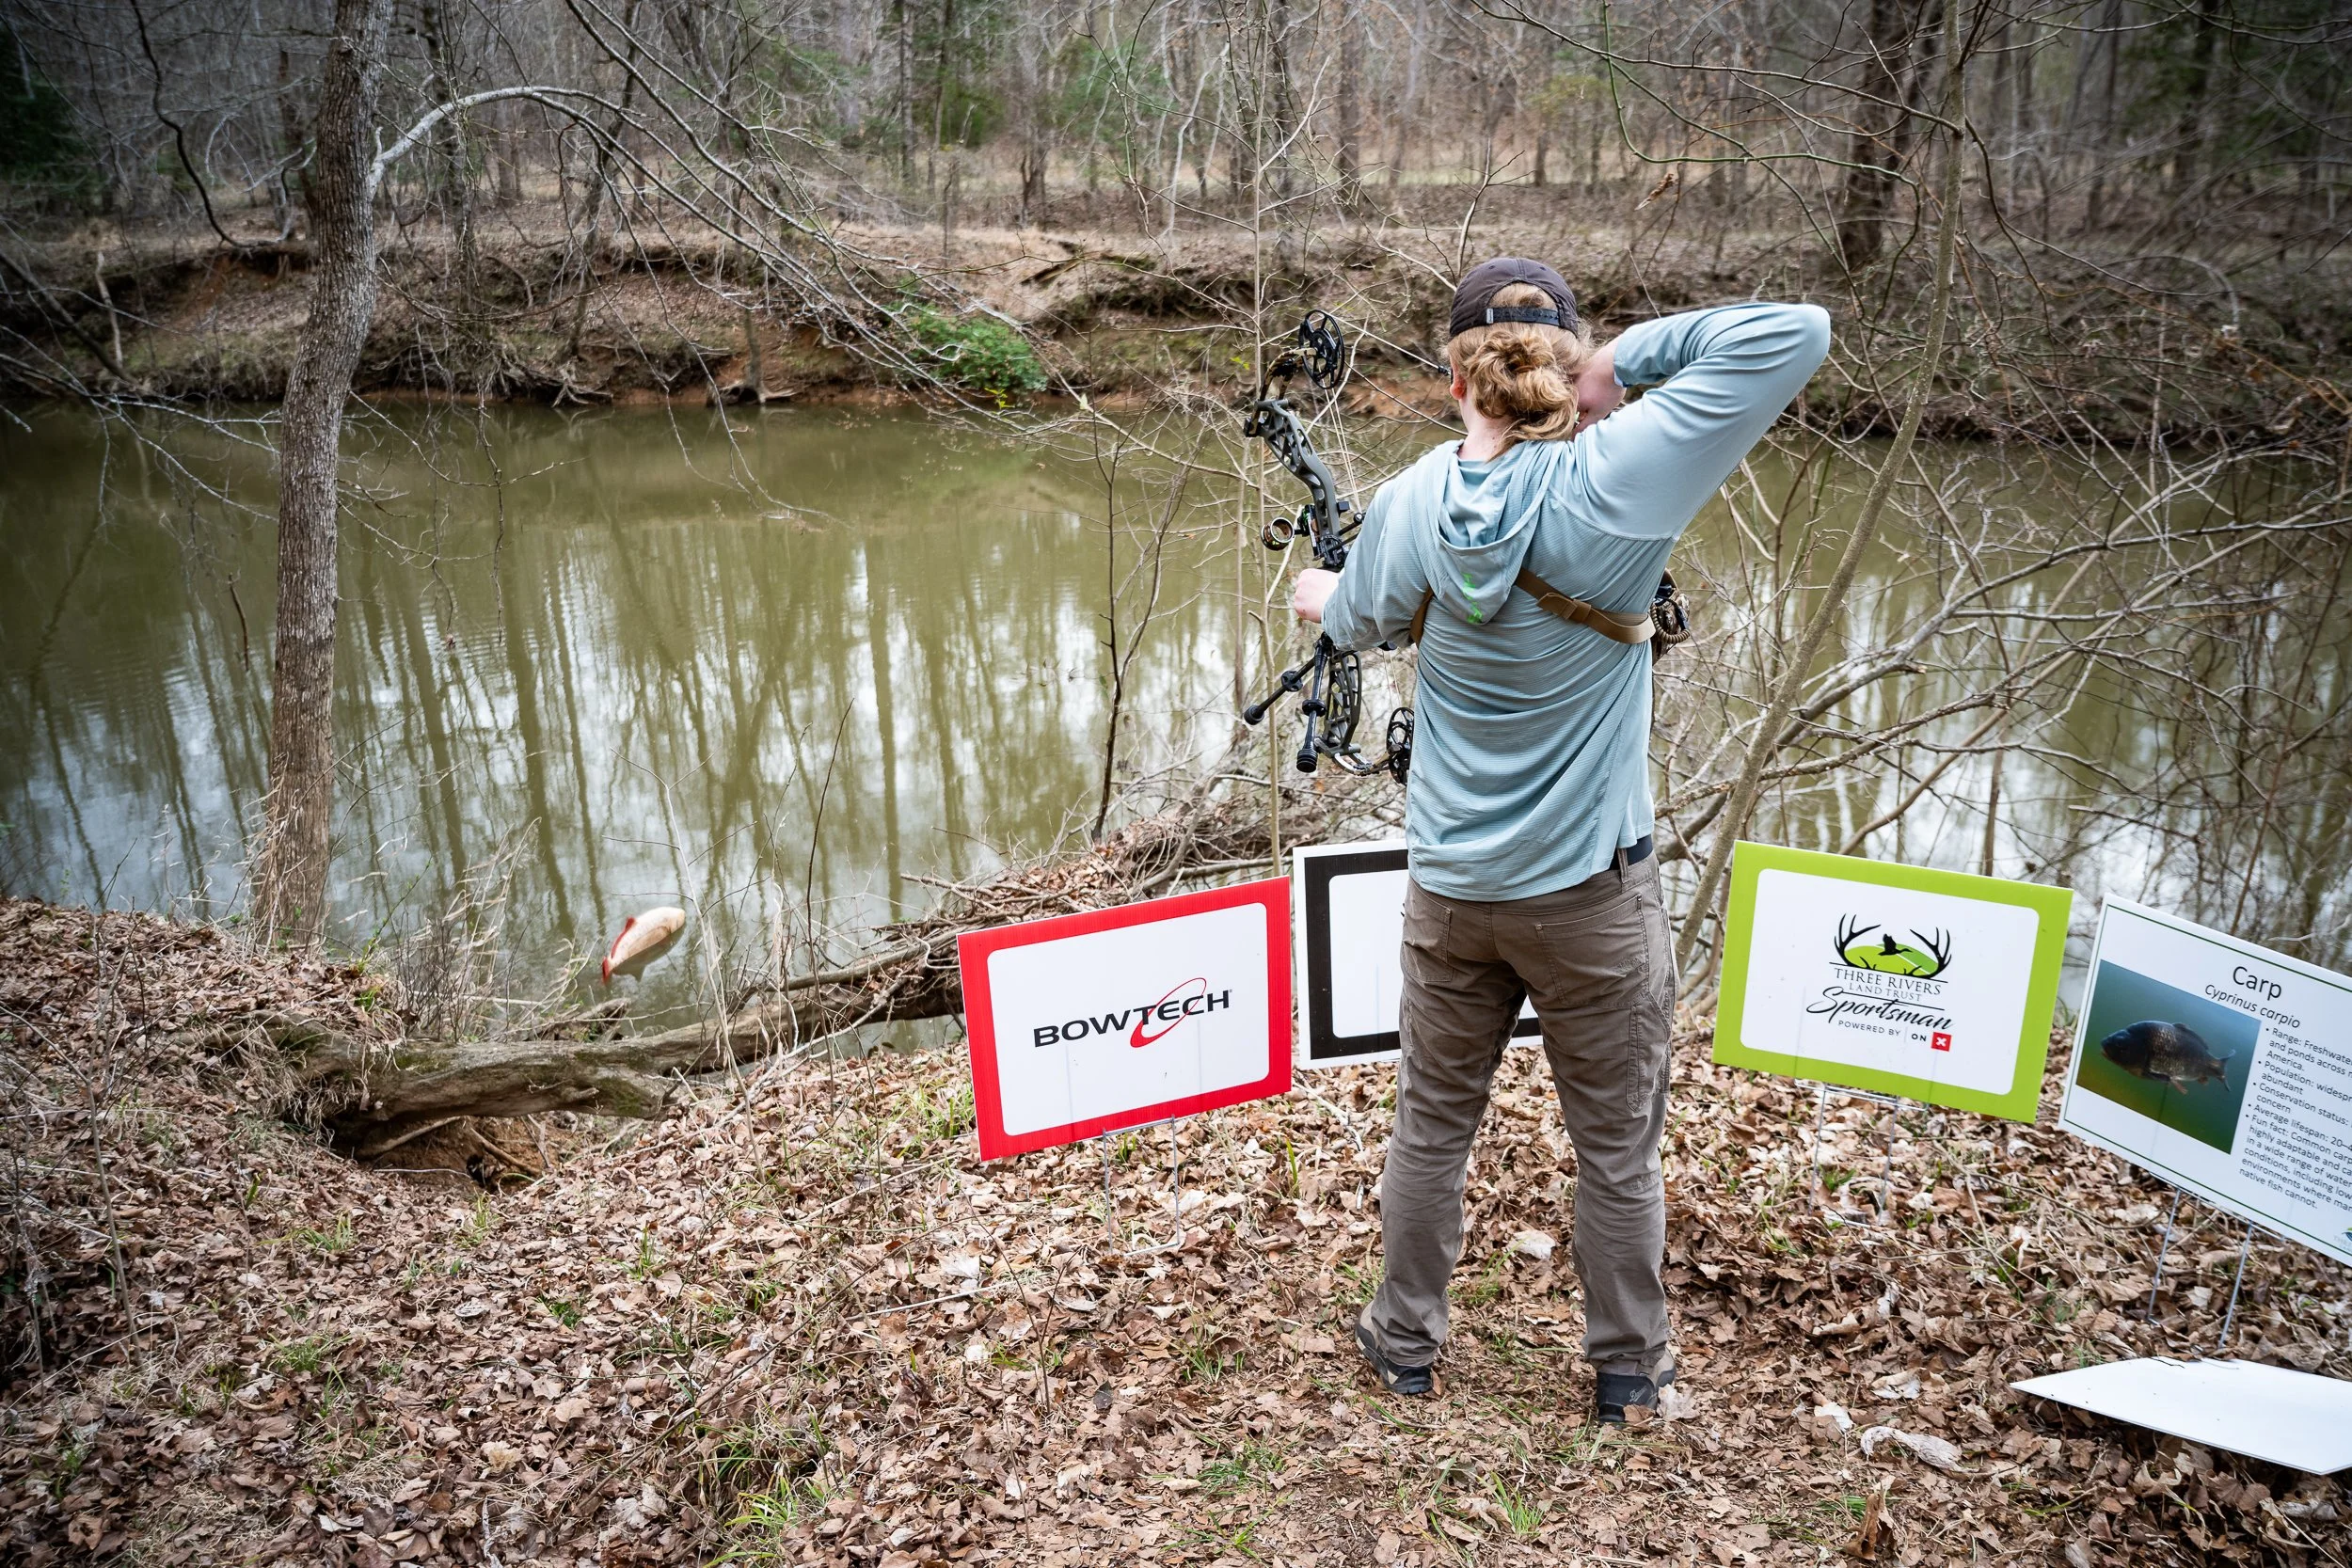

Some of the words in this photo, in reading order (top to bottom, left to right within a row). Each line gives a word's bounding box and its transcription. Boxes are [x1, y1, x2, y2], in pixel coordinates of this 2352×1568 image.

[1834, 967, 1882, 986] THREE
[1888, 977, 1941, 996] RIVERS
[1849, 982, 1882, 996] LAND
[1886, 988, 1922, 1002] TRUST
[2233, 966, 2282, 1001] Carp
[1033, 990, 1230, 1048] BOWTECH
[1806, 986, 1954, 1030] Sportsman
[2205, 984, 2257, 1012] Cyprinus
[2260, 1007, 2300, 1028] carpio
[1838, 1020, 1885, 1034] POWERED
[1889, 1029, 1901, 1037] BY
[2272, 1028, 2301, 1045] Range:
[2264, 1061, 2314, 1087] Population:
[2266, 1050, 2304, 1071] America.
[2269, 1040, 2286, 1051] and
[2288, 1047, 2315, 1063] ponds
[2317, 1059, 2345, 1075] across
[2261, 1072, 2303, 1095] abundant
[2257, 1094, 2291, 1113] concern
[2259, 1083, 2316, 1112] Conservation
[2318, 1109, 2349, 1125] status:
[2252, 1115, 2267, 1126] Fun
[2269, 1122, 2288, 1136] fact:
[2291, 1132, 2331, 1155] Common
[2253, 1104, 2289, 1124] Average
[2291, 1119, 2328, 1141] lifespan:
[2247, 1135, 2255, 1145] in
[2265, 1145, 2285, 1158] wide
[2287, 1155, 2312, 1171] range
[2249, 1125, 2274, 1143] highly
[2277, 1138, 2320, 1163] adaptable
[2322, 1157, 2340, 1171] and
[2240, 1168, 2266, 1185] native
[2268, 1181, 2283, 1193] fish
[2285, 1189, 2318, 1209] cannot.
[2242, 1158, 2301, 1189] environments
[2304, 1186, 2332, 1203] where
[2244, 1148, 2290, 1174] conditions,
[2293, 1168, 2333, 1194] including
